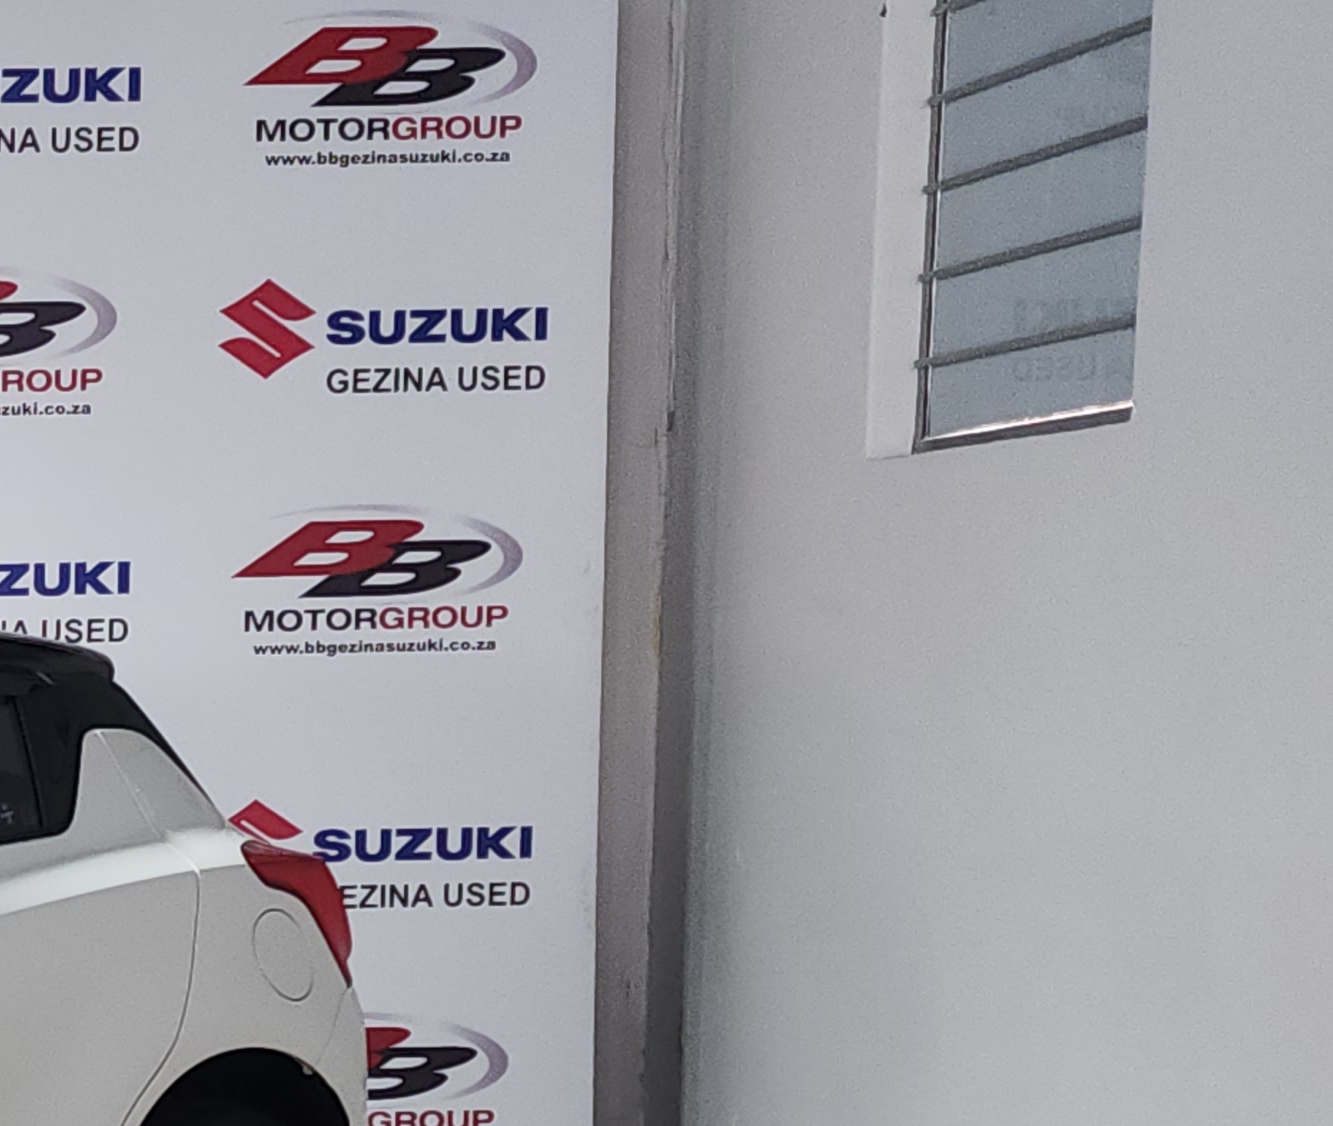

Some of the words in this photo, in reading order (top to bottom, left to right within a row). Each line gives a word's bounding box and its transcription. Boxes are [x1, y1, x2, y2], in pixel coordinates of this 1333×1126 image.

[245, 26, 505, 107] BB
[52, 127, 139, 153] USED
[256, 116, 521, 142] MOTORGROUP
[265, 149, 510, 167] www.bbgezinasuzuki.co.za
[327, 307, 548, 345] SUZUKI
[327, 367, 447, 393] GEZINA
[458, 366, 545, 391] USED
[232, 520, 491, 598] BB
[41, 618, 128, 643] USED
[245, 606, 508, 632] MOTORGROUP
[254, 638, 496, 657] www.bbgezinasuzuki.co.za
[313, 826, 532, 862] SUZUKI
[341, 884, 433, 909] EZINA
[444, 882, 530, 907] USED
